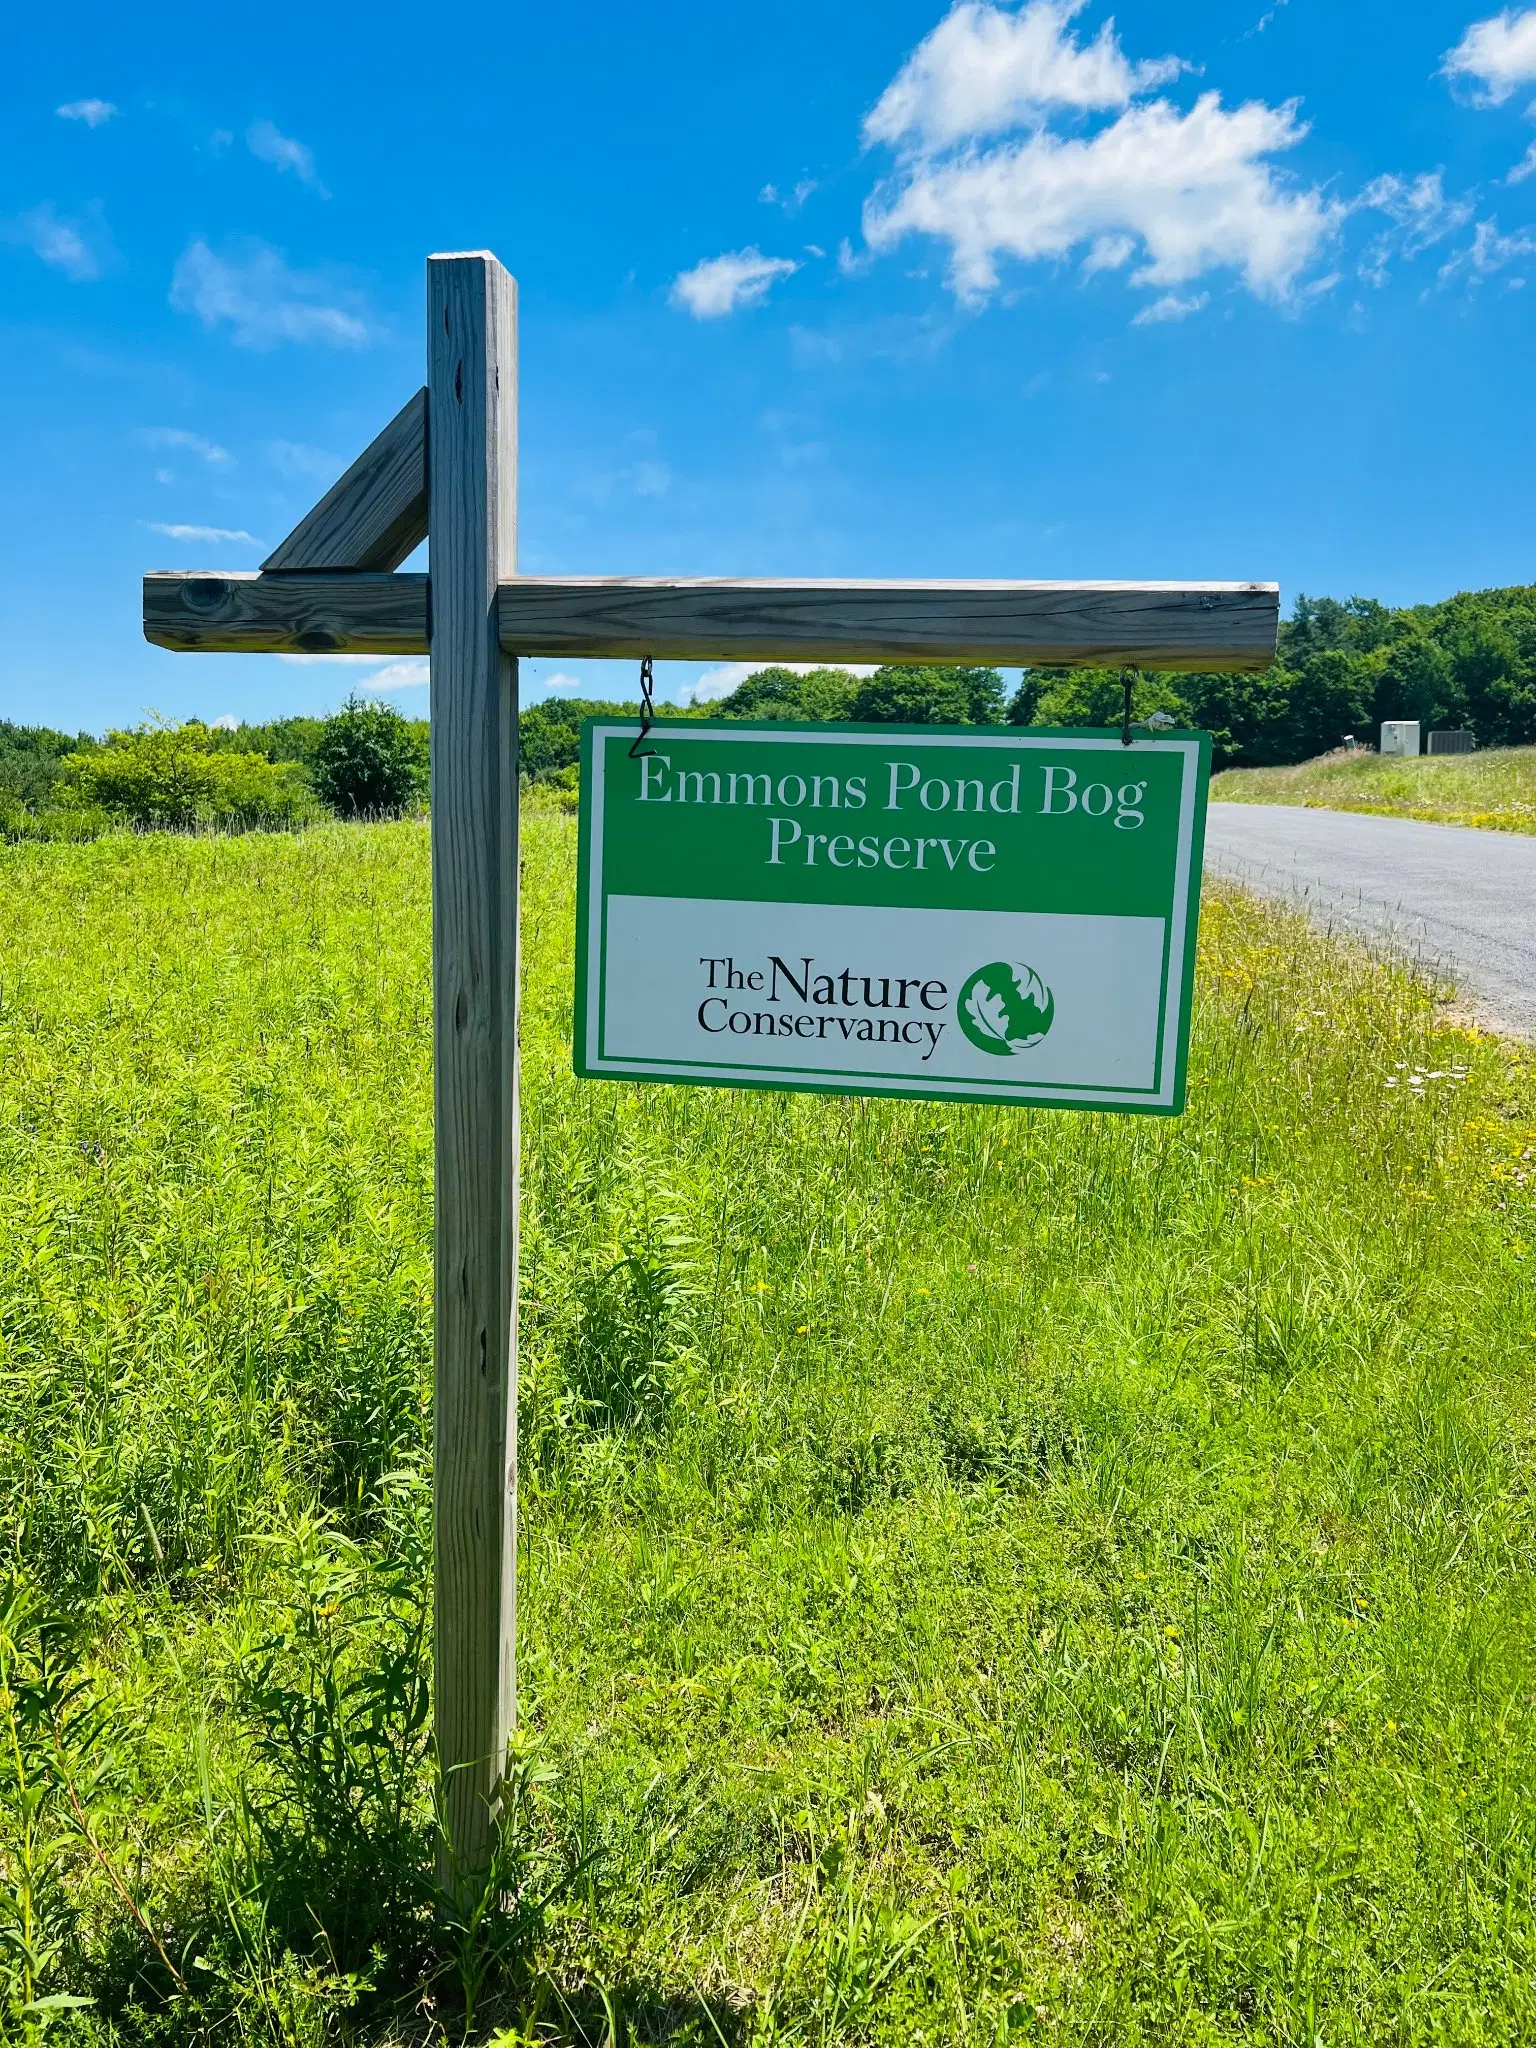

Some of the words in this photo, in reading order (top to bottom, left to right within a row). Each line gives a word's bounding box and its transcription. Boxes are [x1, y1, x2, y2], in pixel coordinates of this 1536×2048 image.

[634, 755, 868, 809] Emmons
[882, 762, 1021, 813] Pond
[1036, 765, 1148, 829] Bog
[765, 817, 997, 872] Preserve
[699, 957, 765, 991] The
[766, 956, 948, 1011] Nature
[697, 997, 947, 1061] Conservancy
